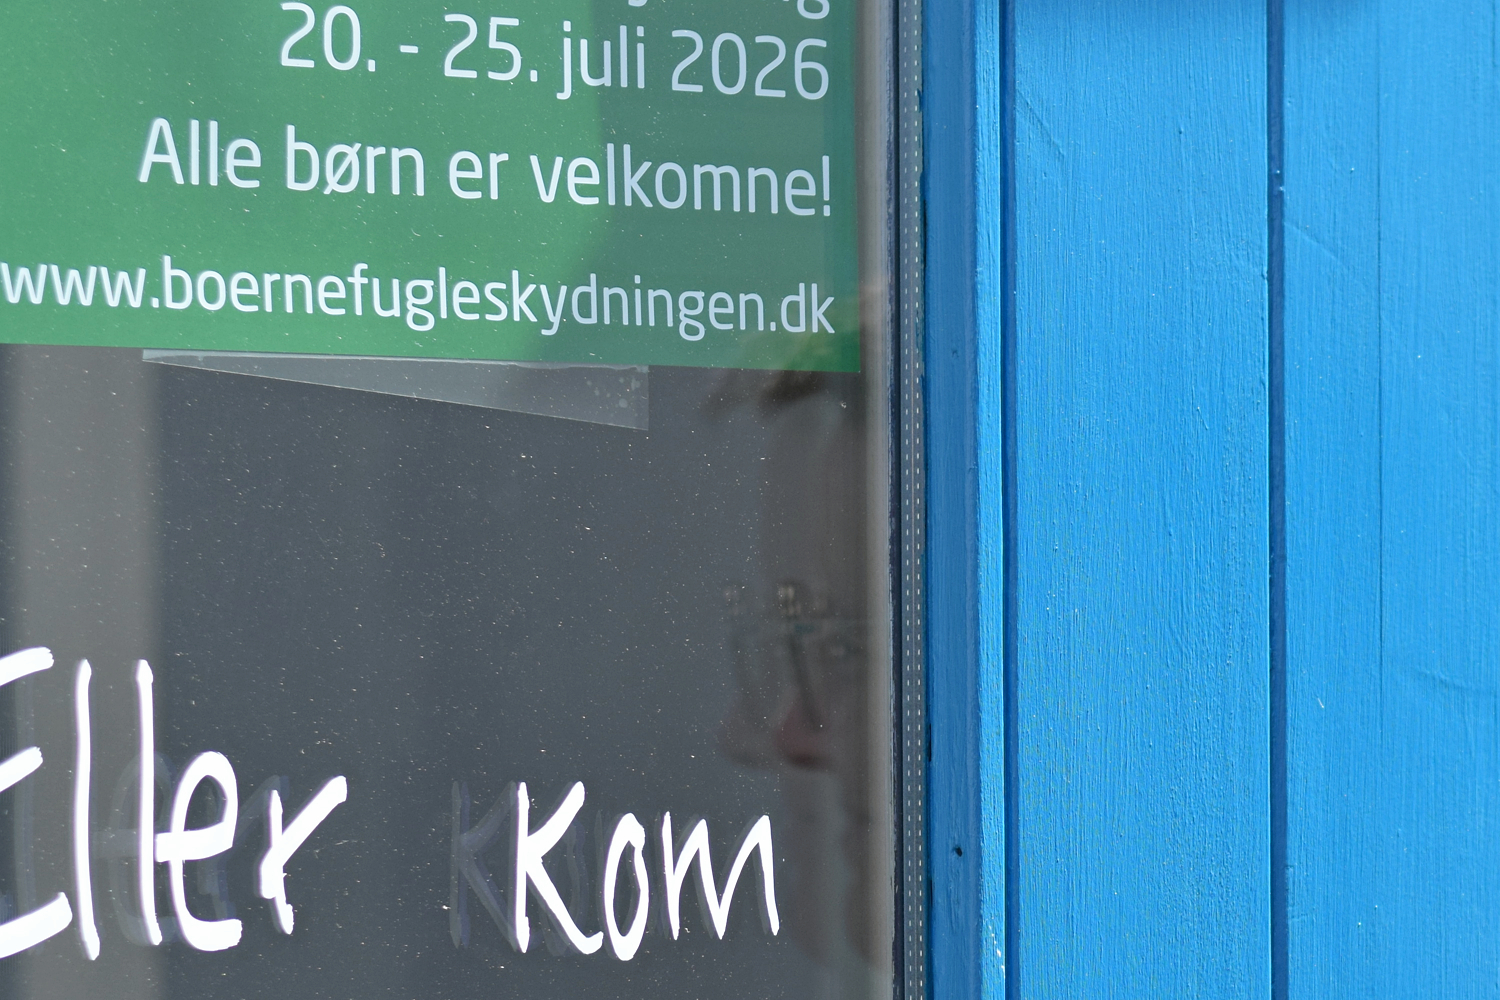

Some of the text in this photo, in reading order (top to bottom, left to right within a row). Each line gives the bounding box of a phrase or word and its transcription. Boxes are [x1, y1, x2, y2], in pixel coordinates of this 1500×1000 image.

[280, 2, 829, 100] 20. - 25. juli 2026
[138, 117, 831, 217] Alle børn er velkomne!
[0, 255, 835, 342] www.boernefugleskydningen.dk
